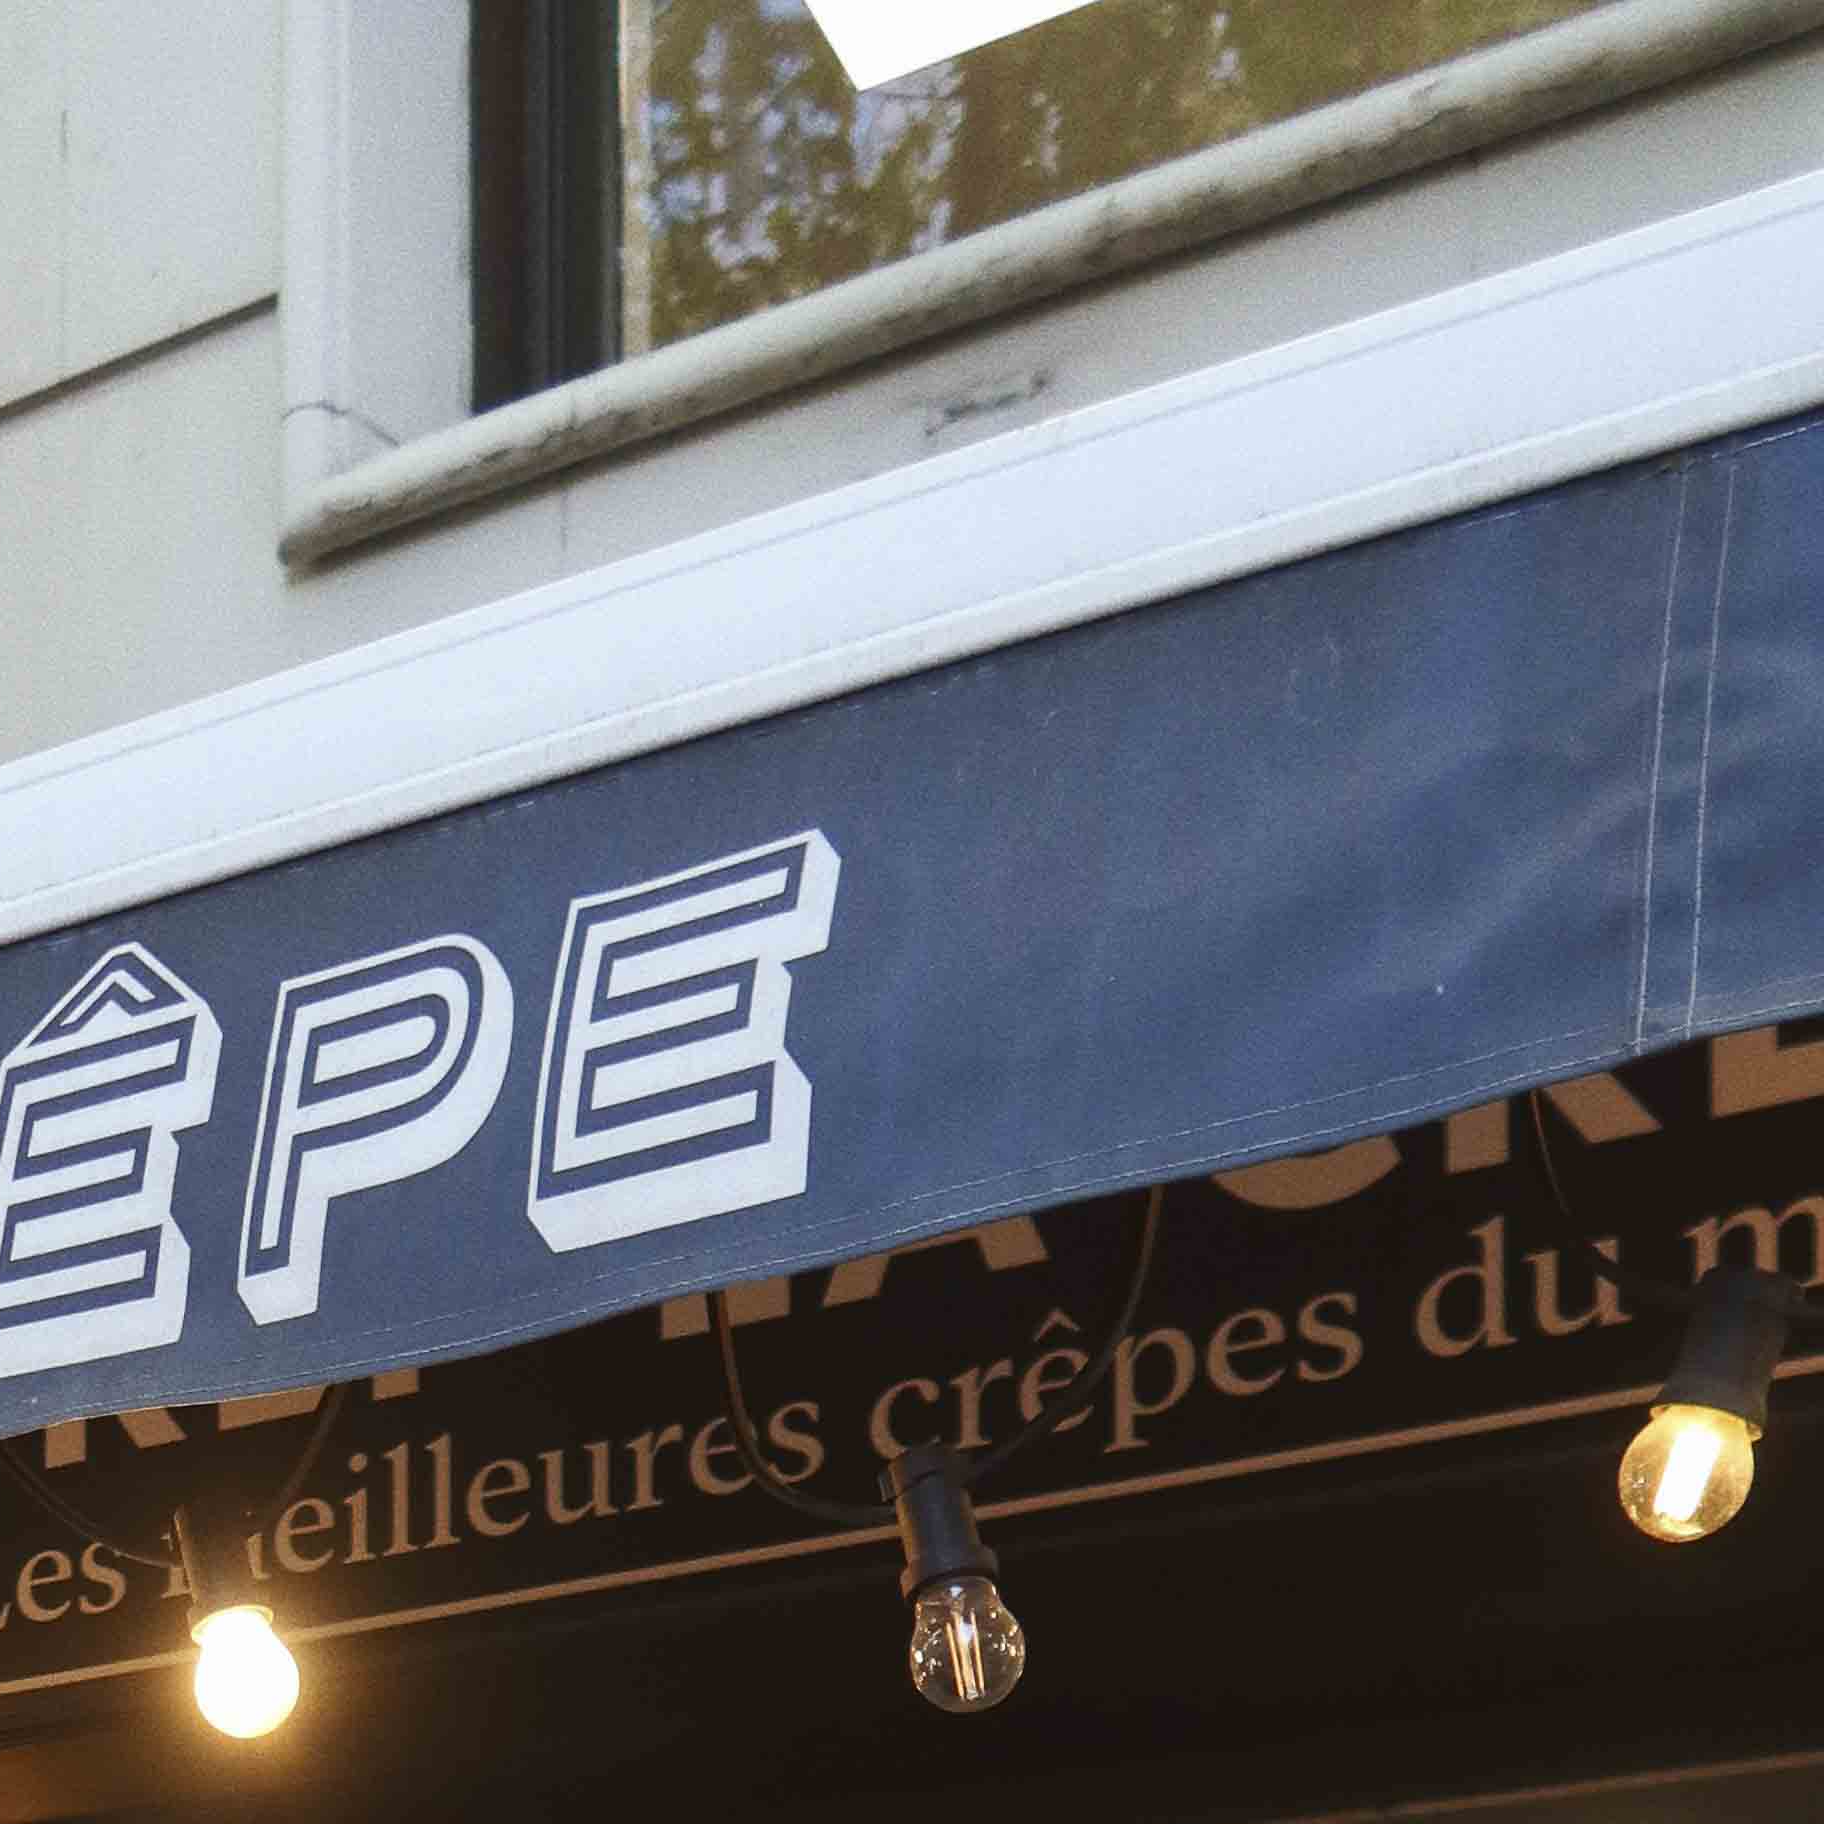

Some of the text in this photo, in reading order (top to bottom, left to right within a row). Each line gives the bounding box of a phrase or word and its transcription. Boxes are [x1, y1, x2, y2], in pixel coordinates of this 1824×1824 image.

[160, 1396, 825, 1600] eilleures
[869, 1289, 1364, 1460] crêpes
[1414, 1215, 1632, 1358] du
